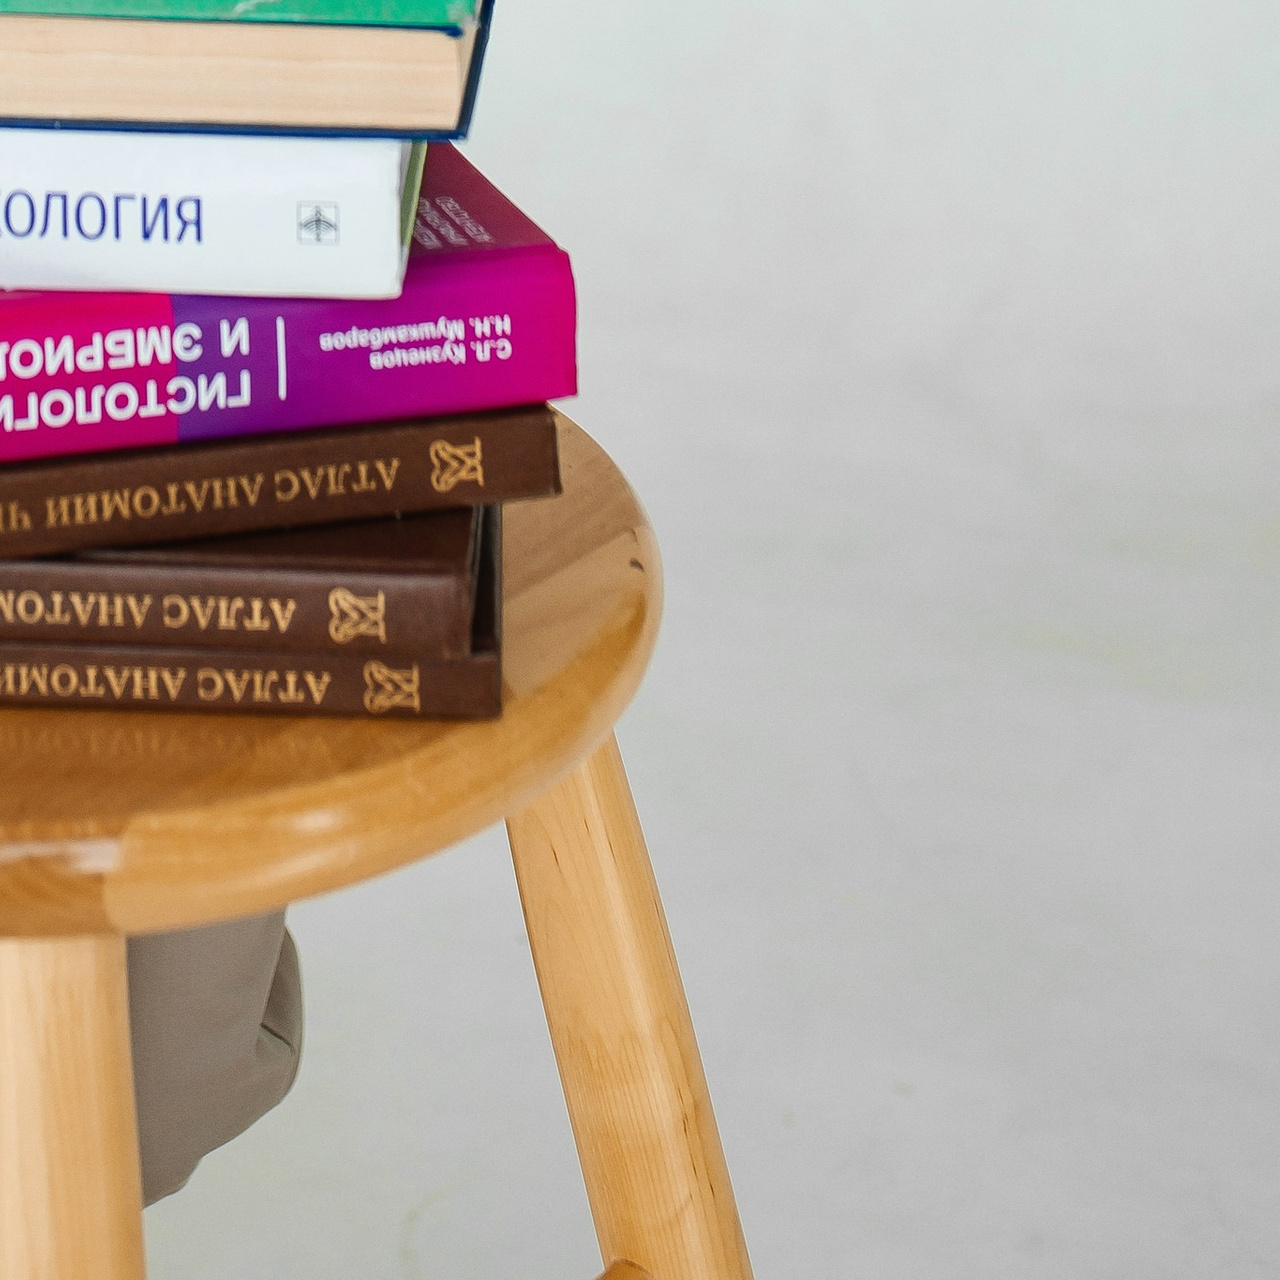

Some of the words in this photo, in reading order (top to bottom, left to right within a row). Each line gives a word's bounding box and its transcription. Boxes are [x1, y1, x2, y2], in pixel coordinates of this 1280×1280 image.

[220, 317, 250, 358] И
[319, 316, 465, 351] Мушкамбаров
[469, 314, 511, 338] Н.Н.
[369, 340, 466, 370] Кузнецов
[274, 458, 400, 502] АТЛАС
[44, 474, 264, 527] АНАТОМИИ
[161, 596, 297, 632] АТЛАС
[197, 669, 331, 703] АТЛАС
